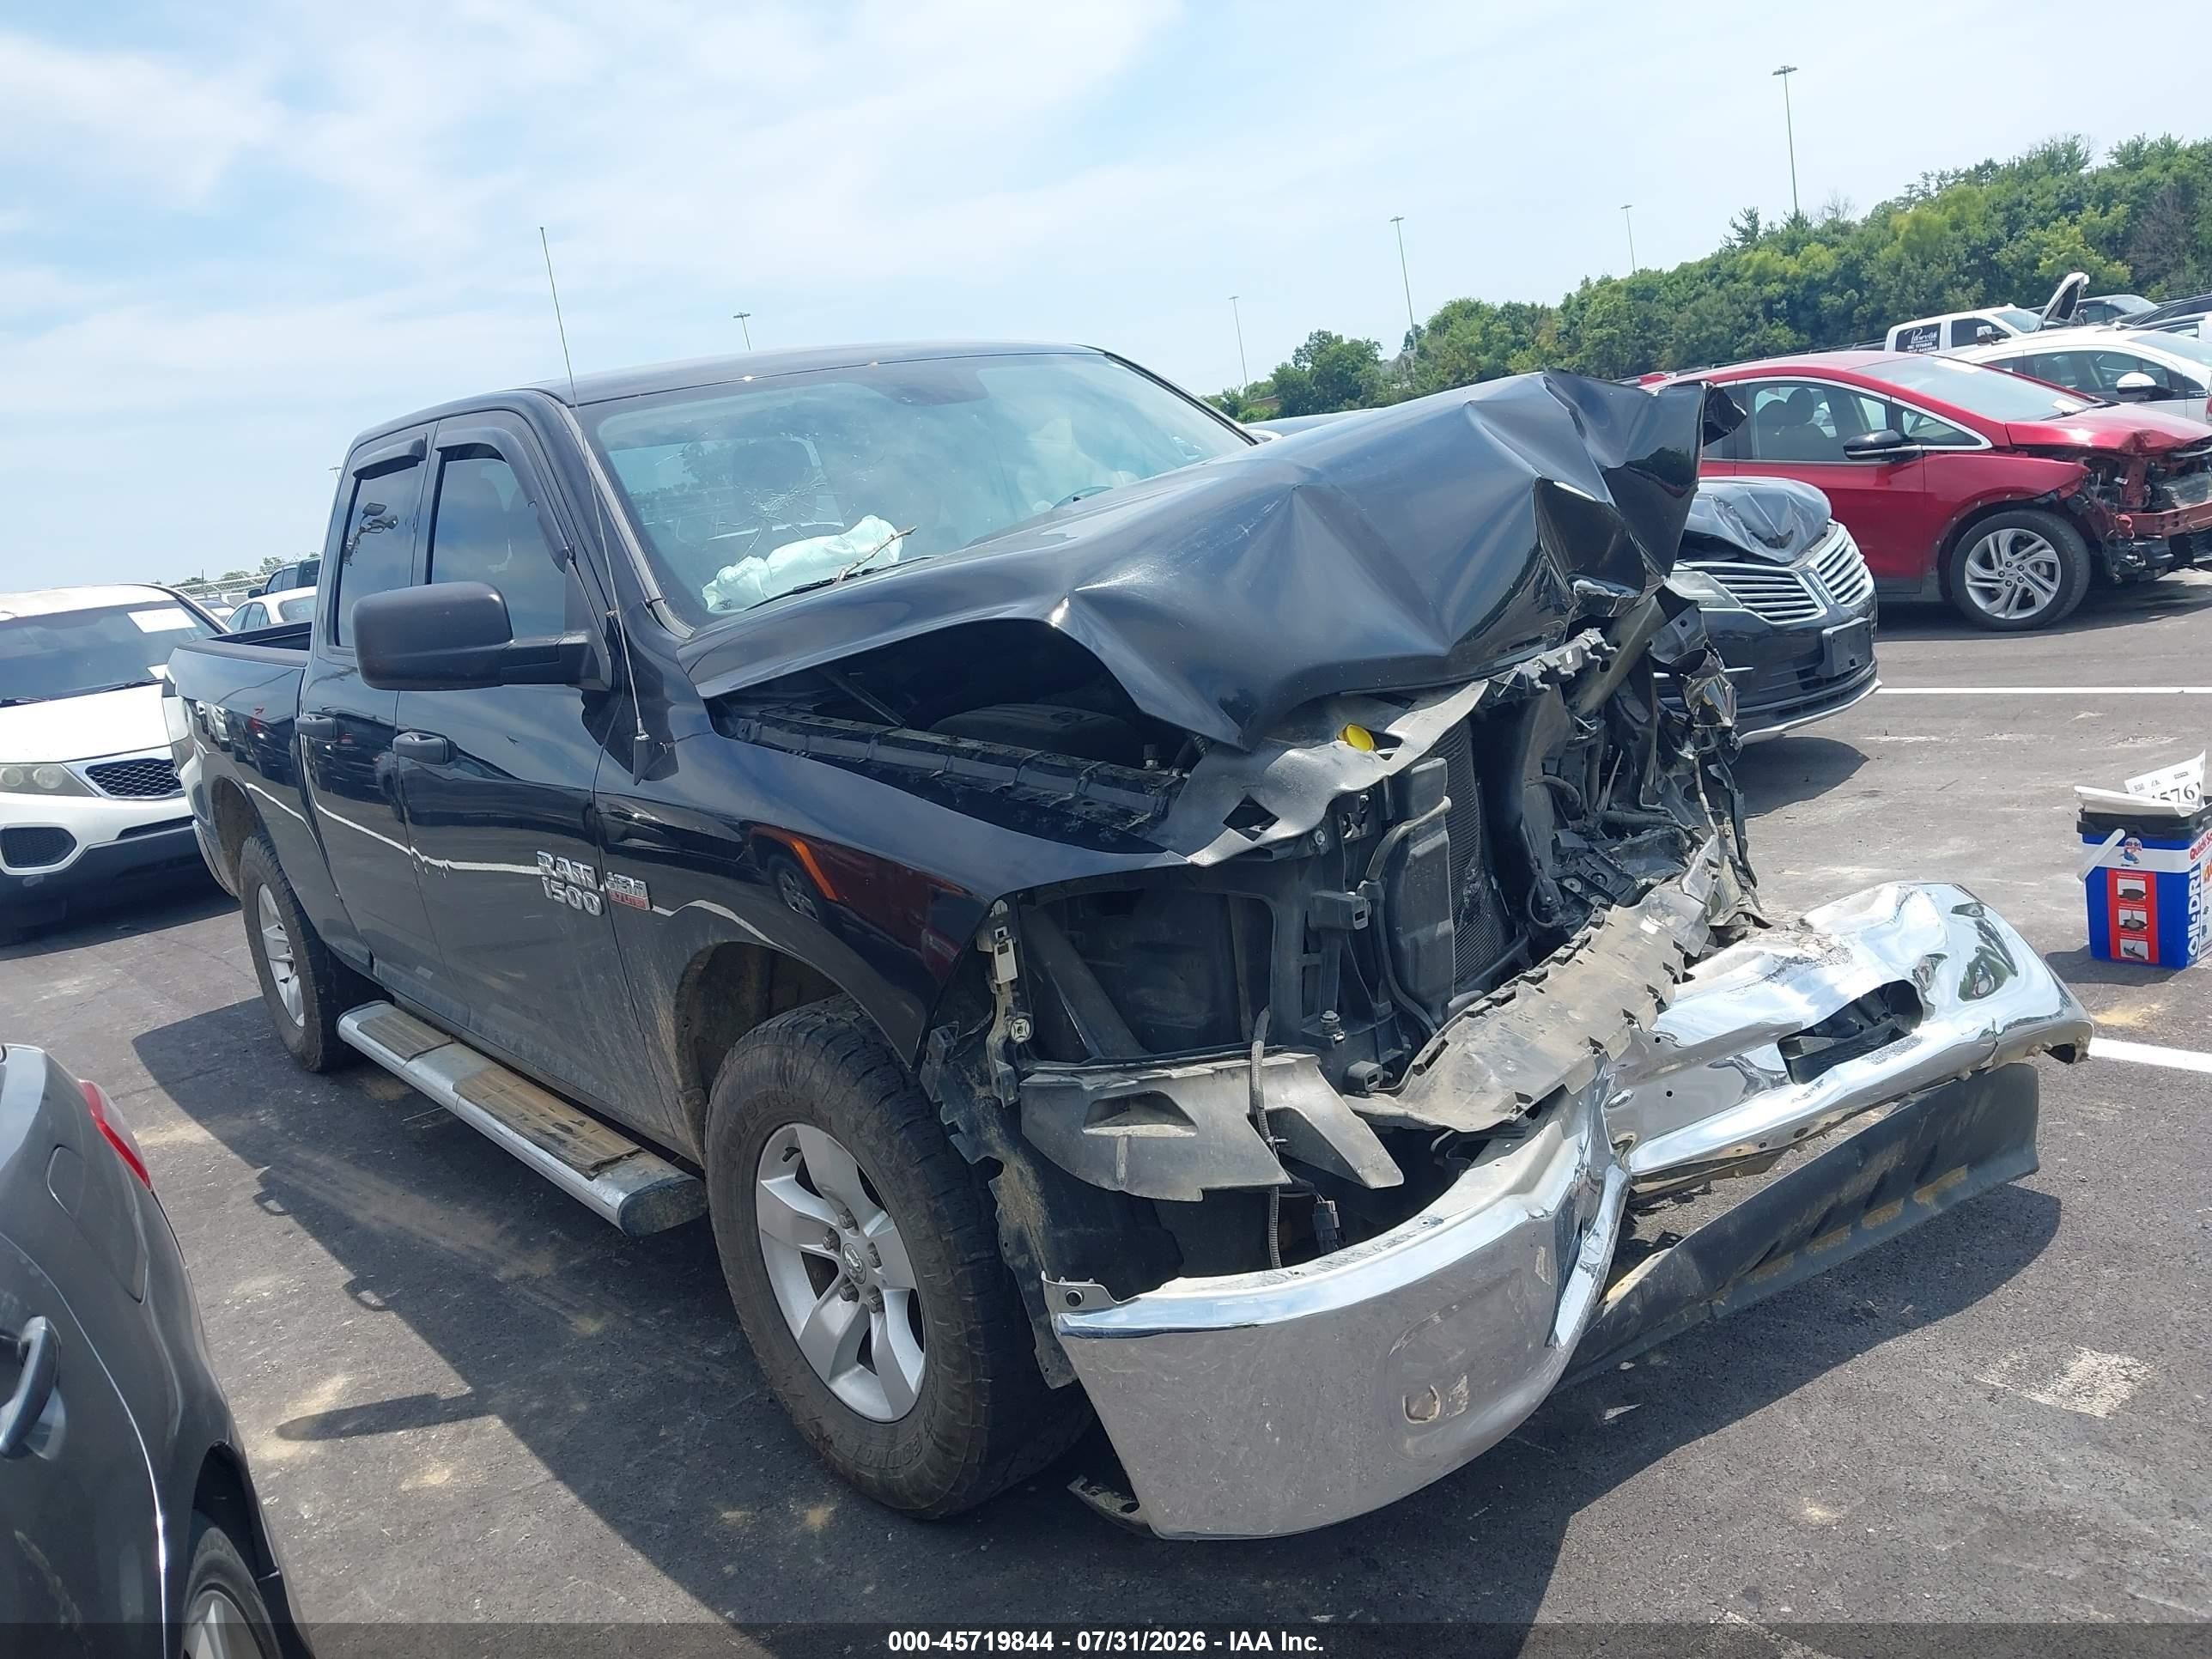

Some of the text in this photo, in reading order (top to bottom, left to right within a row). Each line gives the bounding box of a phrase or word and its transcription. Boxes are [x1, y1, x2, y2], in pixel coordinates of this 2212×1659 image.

[2190, 837, 2207, 860] Quick
[537, 850, 599, 890] RAM
[541, 876, 603, 916] 1500
